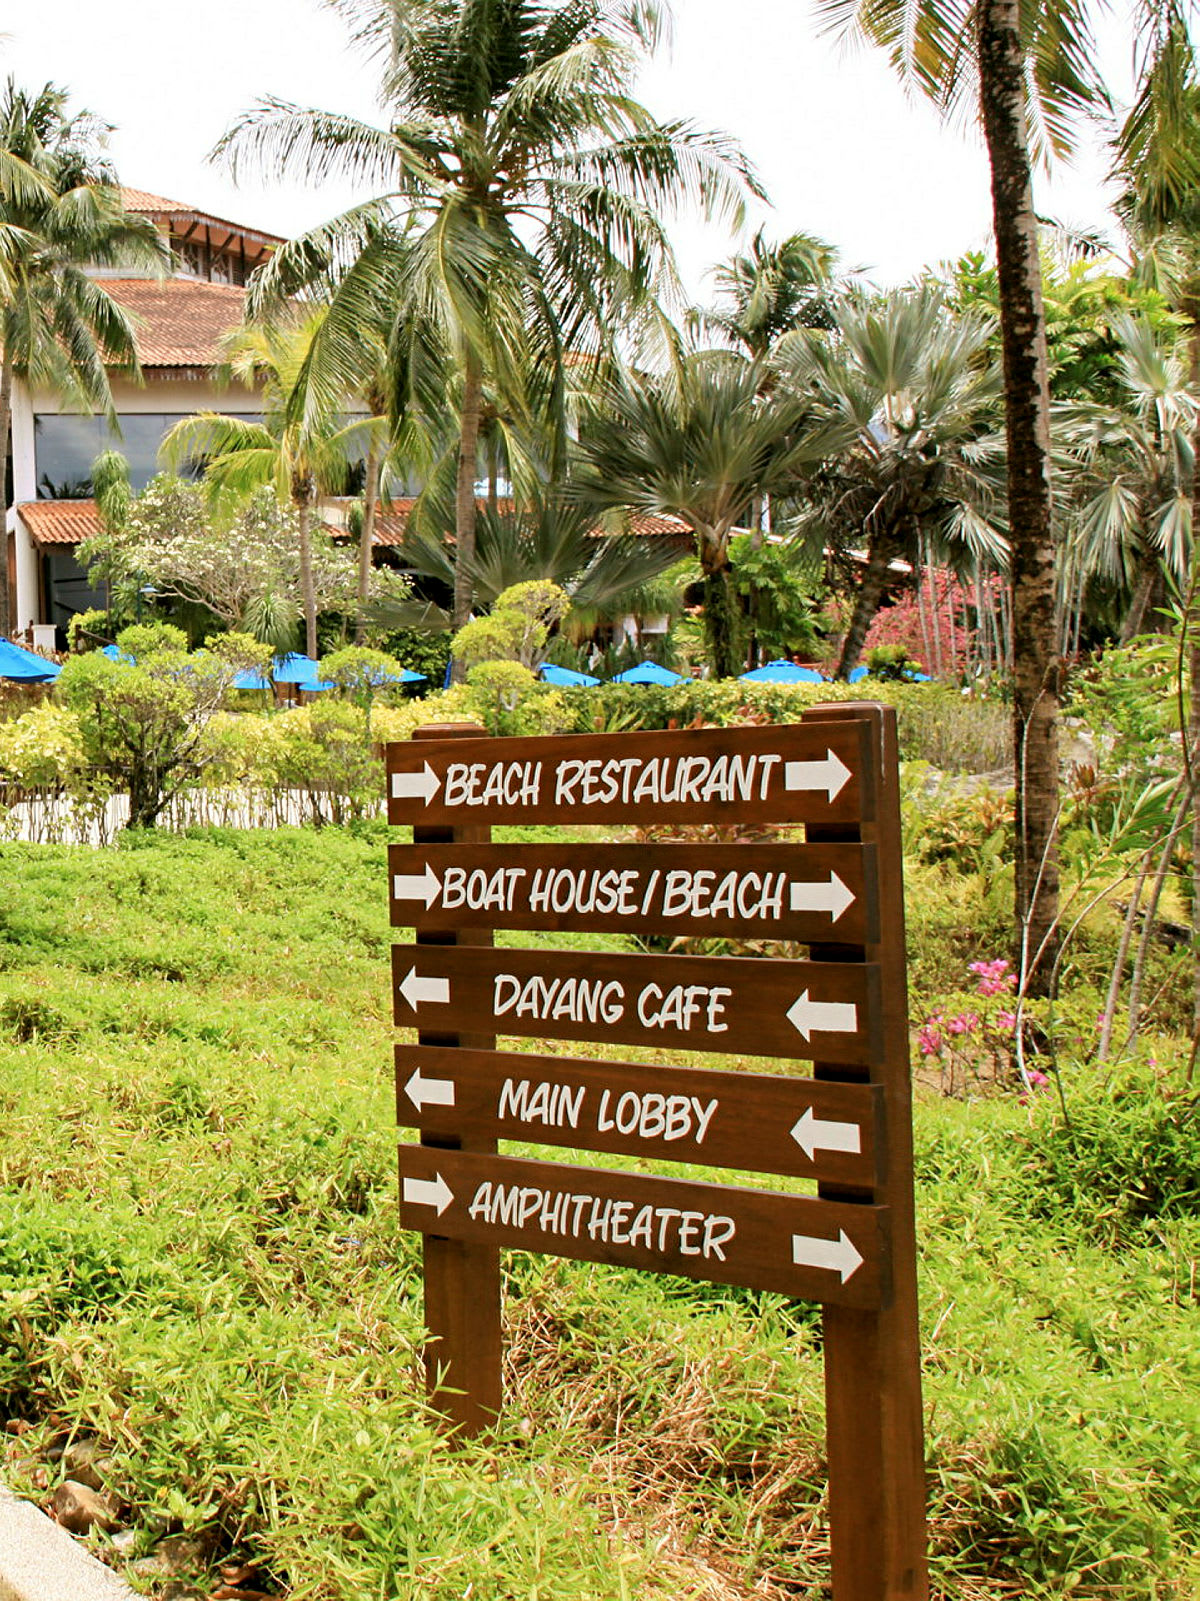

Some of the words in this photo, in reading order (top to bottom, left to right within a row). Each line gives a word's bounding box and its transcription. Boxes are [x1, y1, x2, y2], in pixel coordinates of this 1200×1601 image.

[444, 761, 542, 806] BEACH
[555, 754, 782, 805] RESTAURANT
[442, 867, 526, 911] BOAT
[494, 974, 625, 1024] DAYANG
[637, 982, 732, 1033] CAFE
[498, 1078, 586, 1128] MAIN
[597, 1089, 718, 1144] LOBBY
[468, 1181, 735, 1262] AMPHITHEATER
